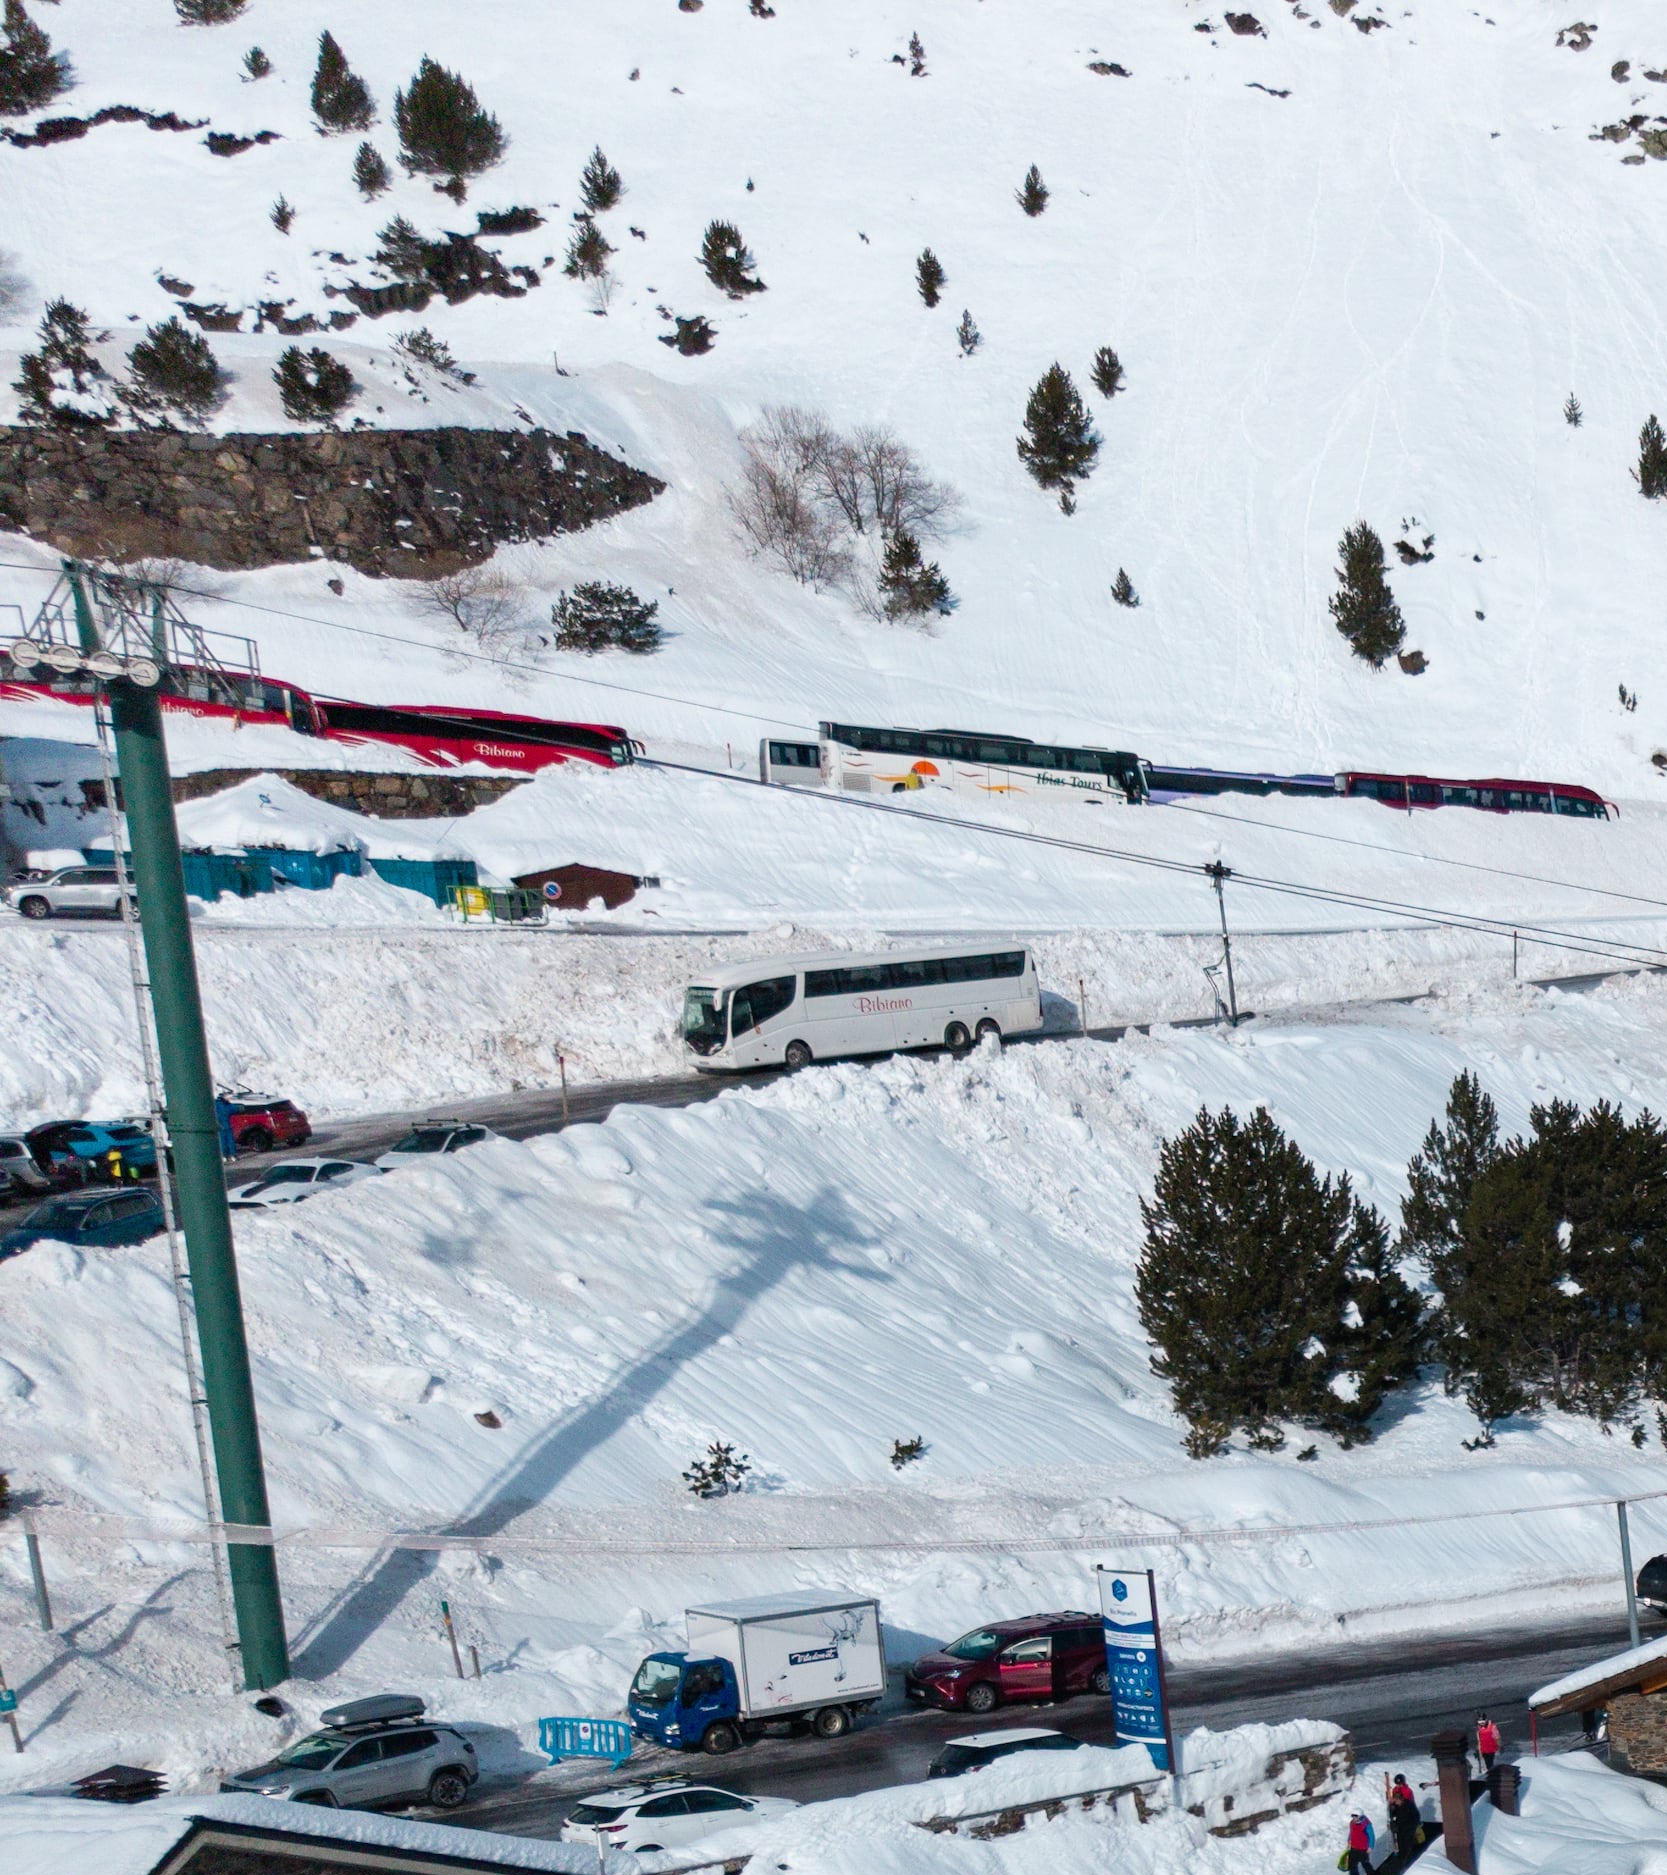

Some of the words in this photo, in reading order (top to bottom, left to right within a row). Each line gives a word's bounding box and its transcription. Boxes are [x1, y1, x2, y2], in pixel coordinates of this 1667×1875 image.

[161, 702, 205, 717] ibiano
[473, 743, 526, 759] Bibiano
[1070, 775, 1104, 790] Tours
[853, 995, 913, 1014] Bibiano
